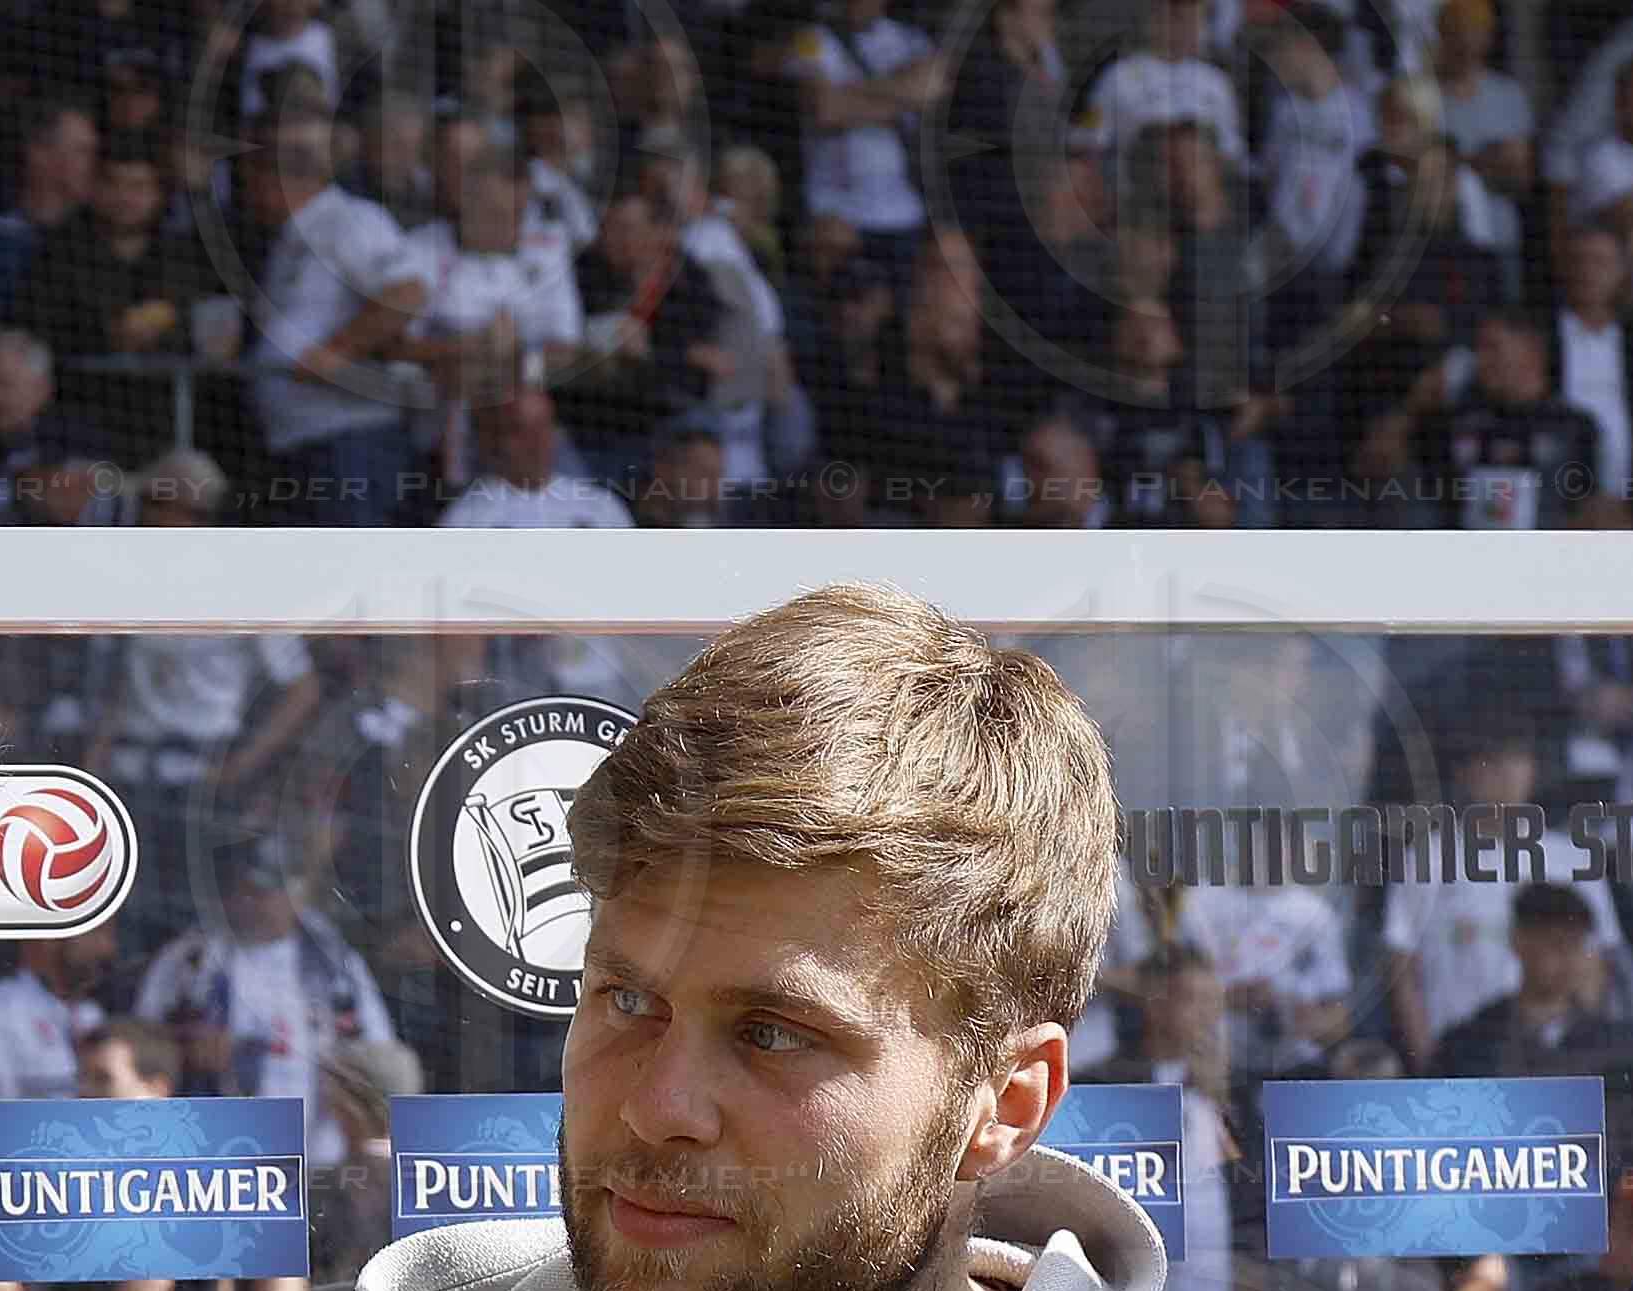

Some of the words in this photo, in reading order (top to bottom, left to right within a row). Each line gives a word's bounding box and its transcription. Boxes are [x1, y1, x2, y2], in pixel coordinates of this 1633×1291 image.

[462, 735, 497, 770] SK
[500, 711, 586, 745] STURM
[505, 967, 560, 1001] SEIT
[1287, 1141, 1589, 1197] PUNTIGAMER
